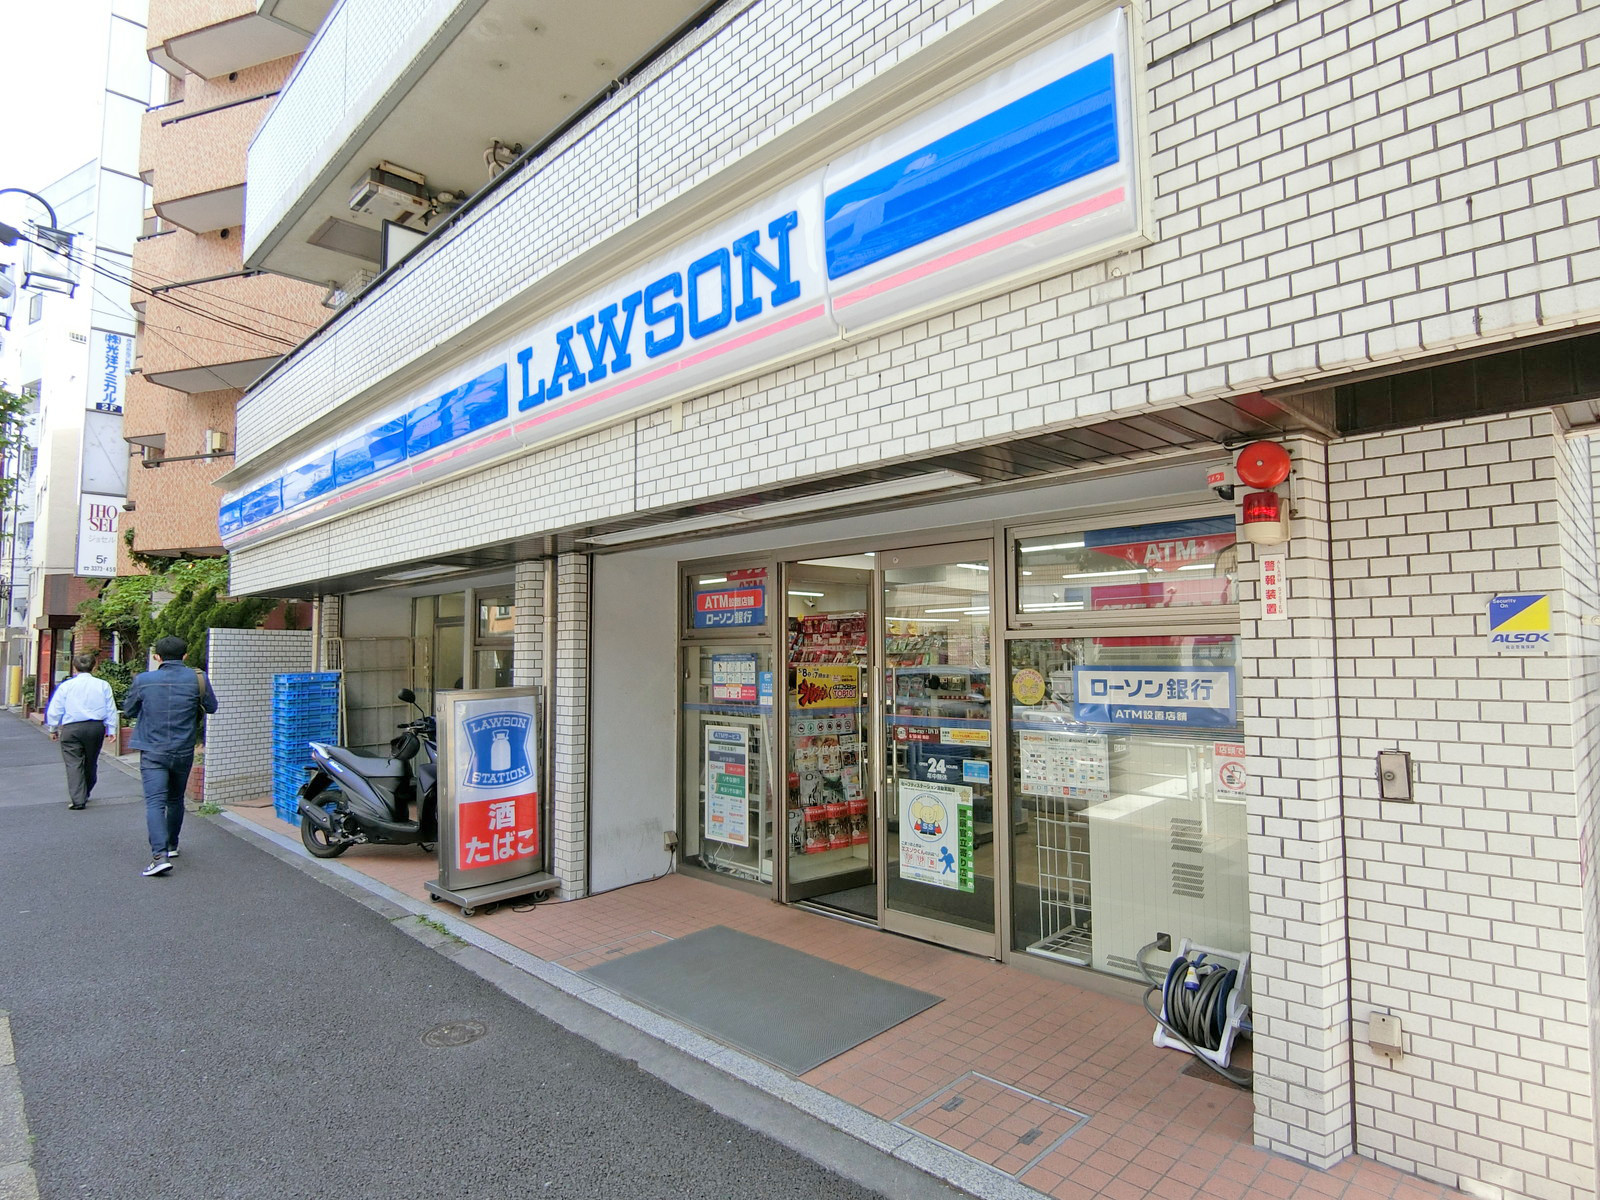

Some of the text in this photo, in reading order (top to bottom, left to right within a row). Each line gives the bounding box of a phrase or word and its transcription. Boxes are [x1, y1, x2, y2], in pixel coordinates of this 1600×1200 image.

[517, 210, 800, 413] LAWSON
[101, 403, 118, 411] 2F
[89, 517, 118, 532] SEL
[1143, 540, 1196, 563] ATM
[1264, 560, 1277, 614] 警報装置
[706, 611, 752, 625] ローソン銀行
[1491, 633, 1550, 643] ALSOK
[1090, 678, 1213, 700] ローソン銀行
[1115, 709, 1187, 722] ATM設置店舗
[471, 717, 527, 733] LAWSON
[928, 758, 946, 774] 24
[471, 766, 527, 784] STATION
[488, 801, 516, 830] 酒
[466, 829, 534, 863] たばこ
